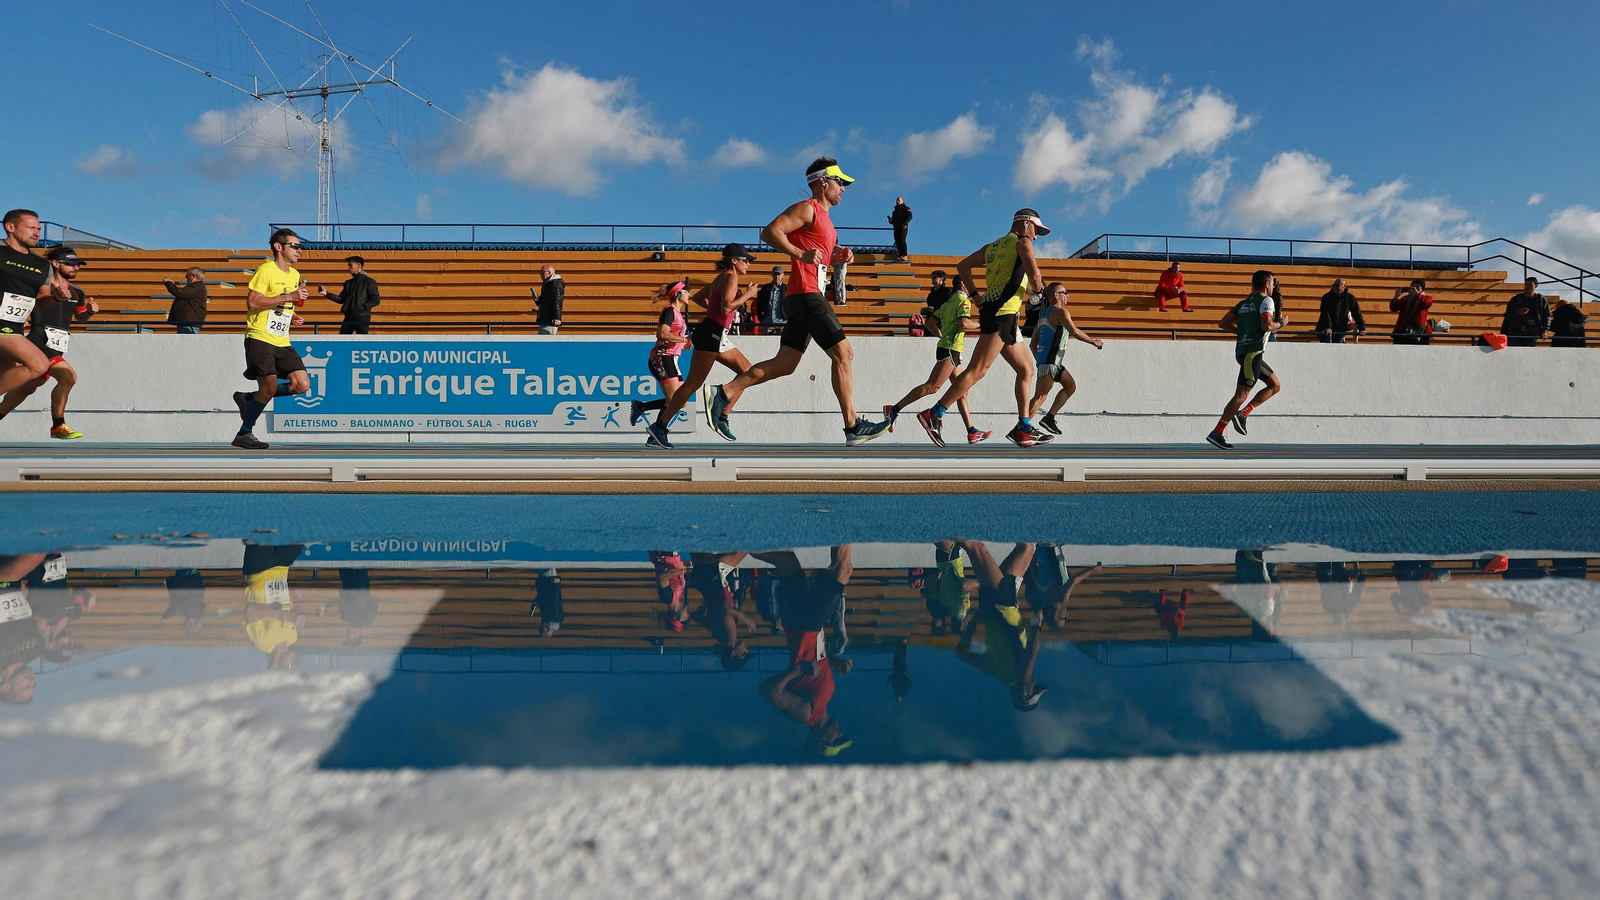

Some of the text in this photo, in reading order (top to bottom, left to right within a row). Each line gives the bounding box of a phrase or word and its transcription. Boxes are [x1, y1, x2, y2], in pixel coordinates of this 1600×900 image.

[5, 305, 27, 317] 327
[270, 320, 287, 332] 282
[351, 350, 511, 364] ESTADIO MUNICIPAL
[351, 366, 658, 403] Enrique Talavera
[283, 419, 338, 428] ATLETISMO
[350, 419, 414, 428] BALONMANO
[426, 417, 465, 428] FÚTBOL
[467, 419, 493, 428] SALA
[505, 419, 539, 428] RUGBY
